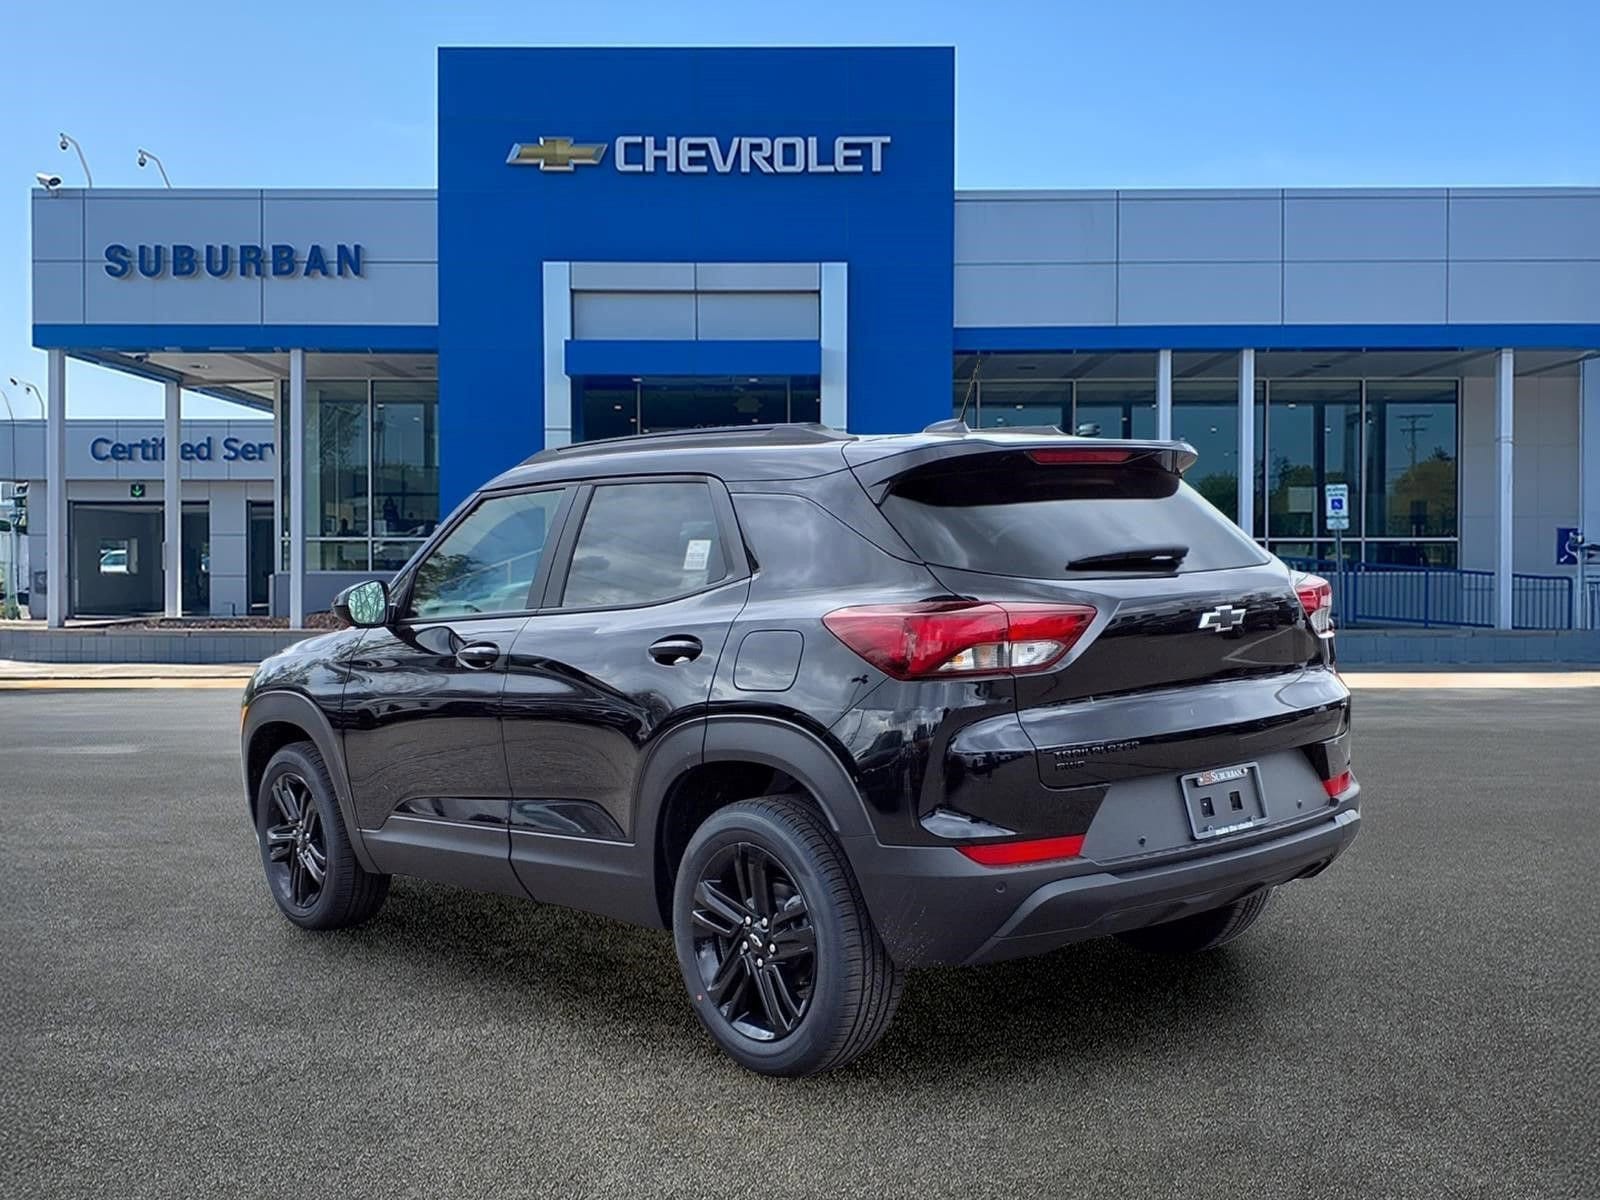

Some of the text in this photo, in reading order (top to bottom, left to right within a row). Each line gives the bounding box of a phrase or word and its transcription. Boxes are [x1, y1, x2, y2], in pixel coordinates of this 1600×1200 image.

[615, 135, 892, 173] CHEVROLET
[104, 244, 363, 277] SUBURBAN
[90, 436, 213, 462] Certifed
